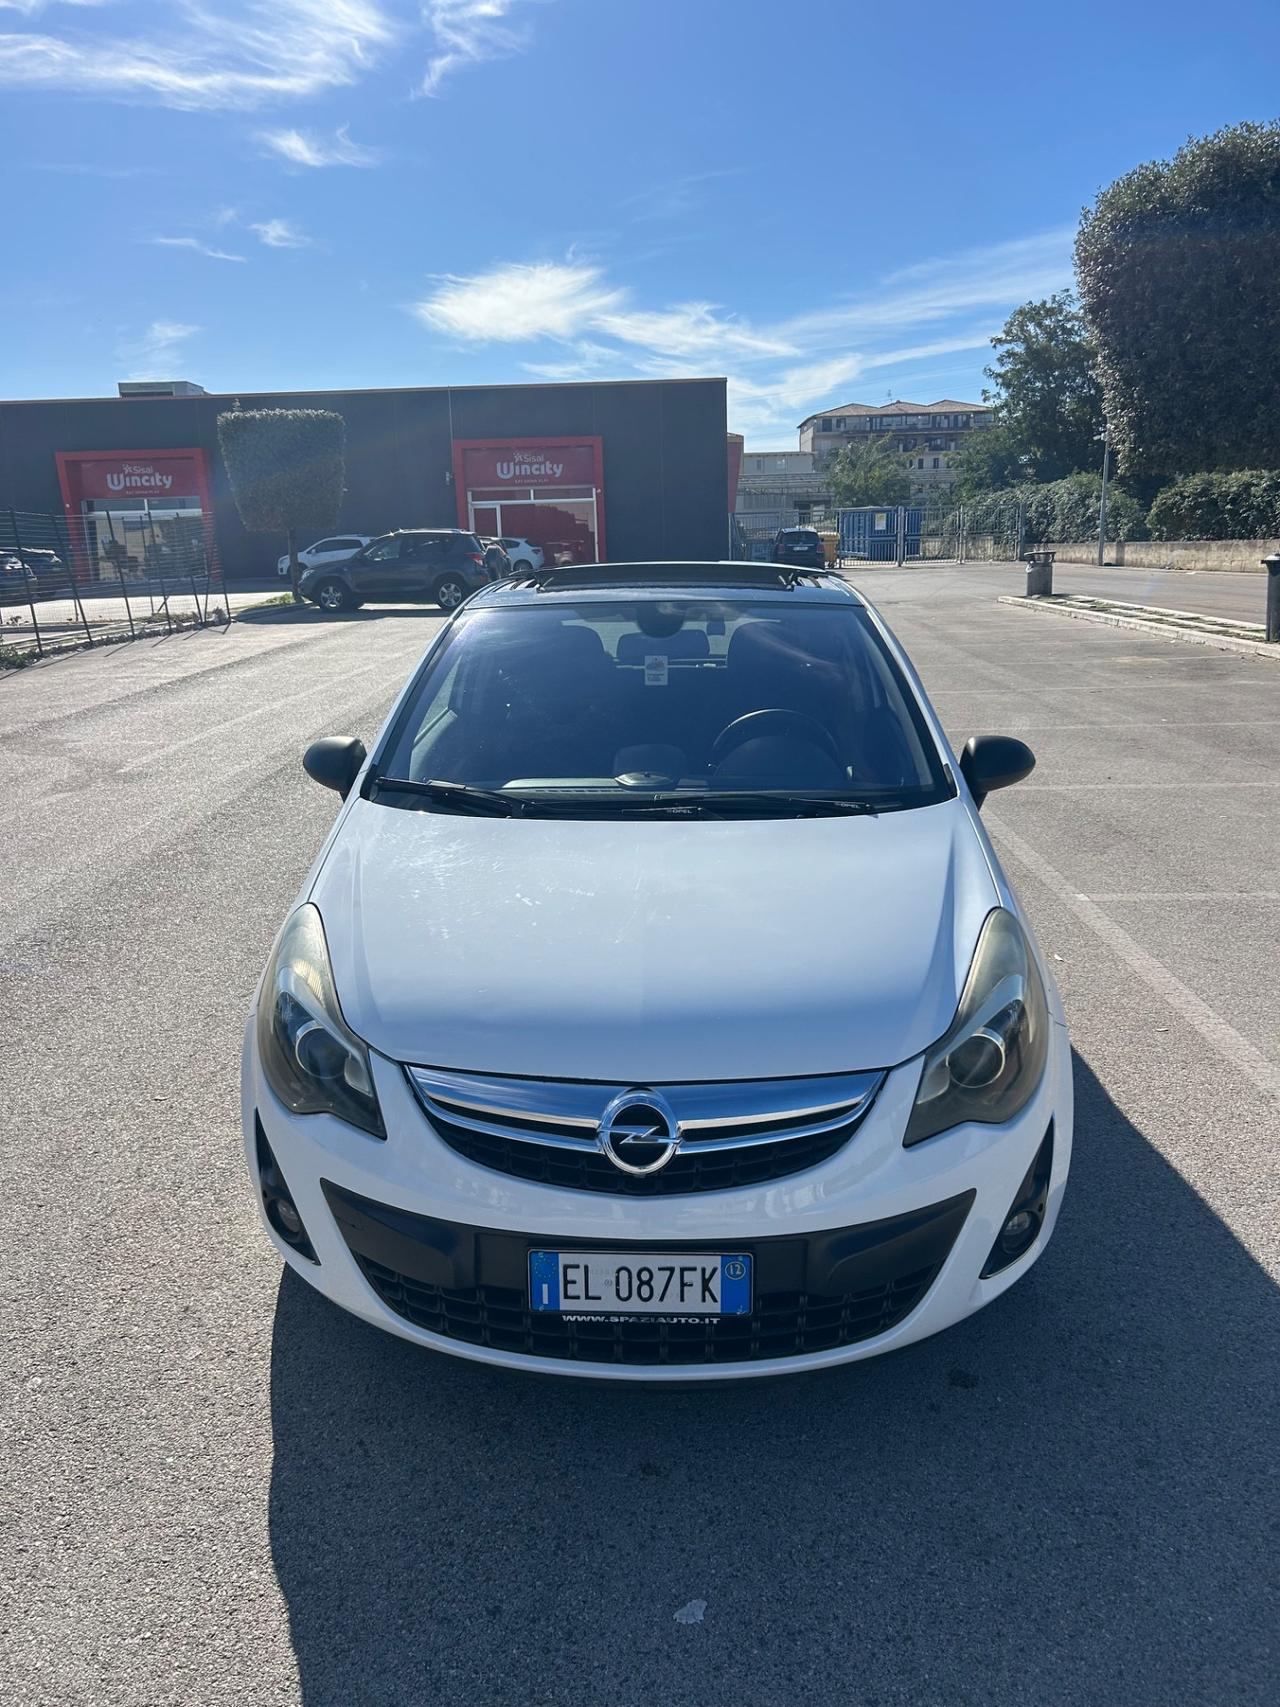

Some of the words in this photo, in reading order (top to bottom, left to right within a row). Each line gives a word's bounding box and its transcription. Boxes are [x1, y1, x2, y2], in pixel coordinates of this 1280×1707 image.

[523, 453, 545, 463] Sisal
[496, 461, 563, 480] Wincity
[106, 472, 173, 491] Wincity
[562, 1263, 602, 1301] EL
[614, 1265, 720, 1304] 087FK
